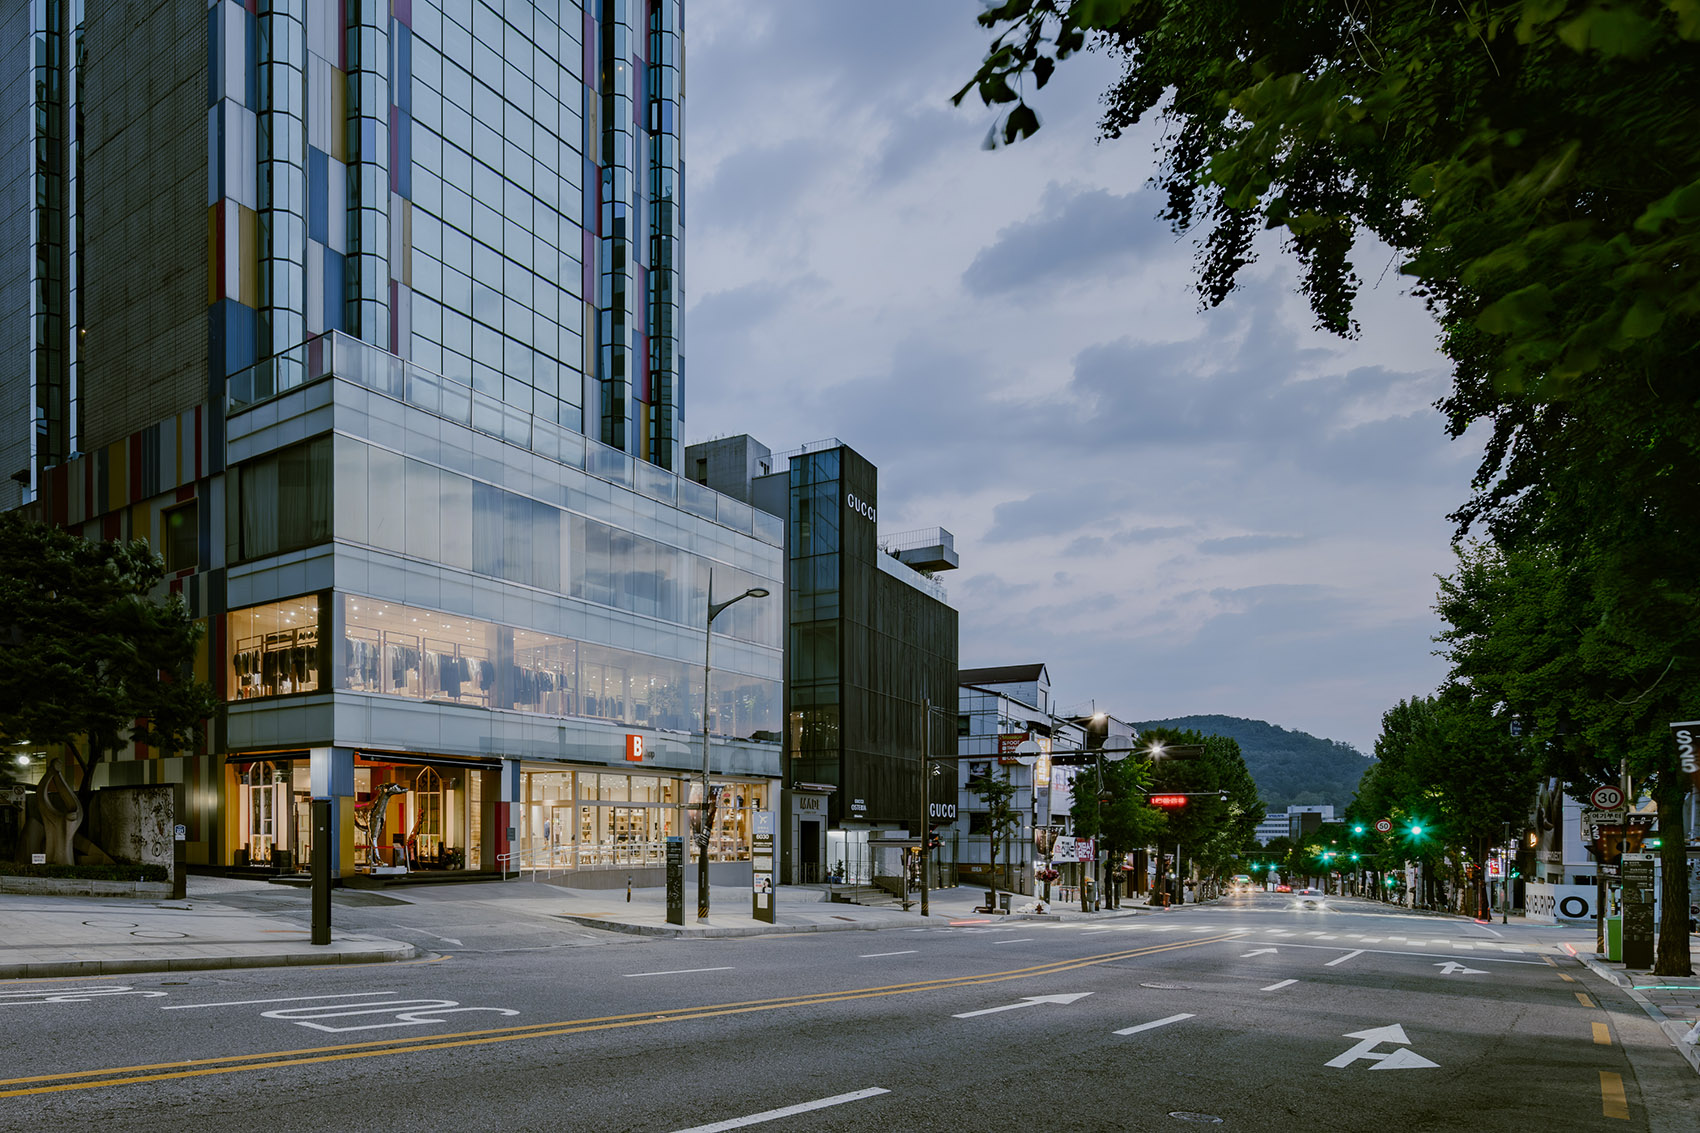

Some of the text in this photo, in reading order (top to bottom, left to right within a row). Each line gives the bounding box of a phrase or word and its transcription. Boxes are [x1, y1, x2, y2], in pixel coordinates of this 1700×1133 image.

[847, 493, 876, 523] GUCCI
[633, 736, 642, 757] B
[1676, 730, 1697, 773] S25
[1597, 792, 1618, 804] 30
[929, 803, 955, 818] GUCCI
[1379, 822, 1389, 830] 50
[1591, 824, 1601, 840] 25
